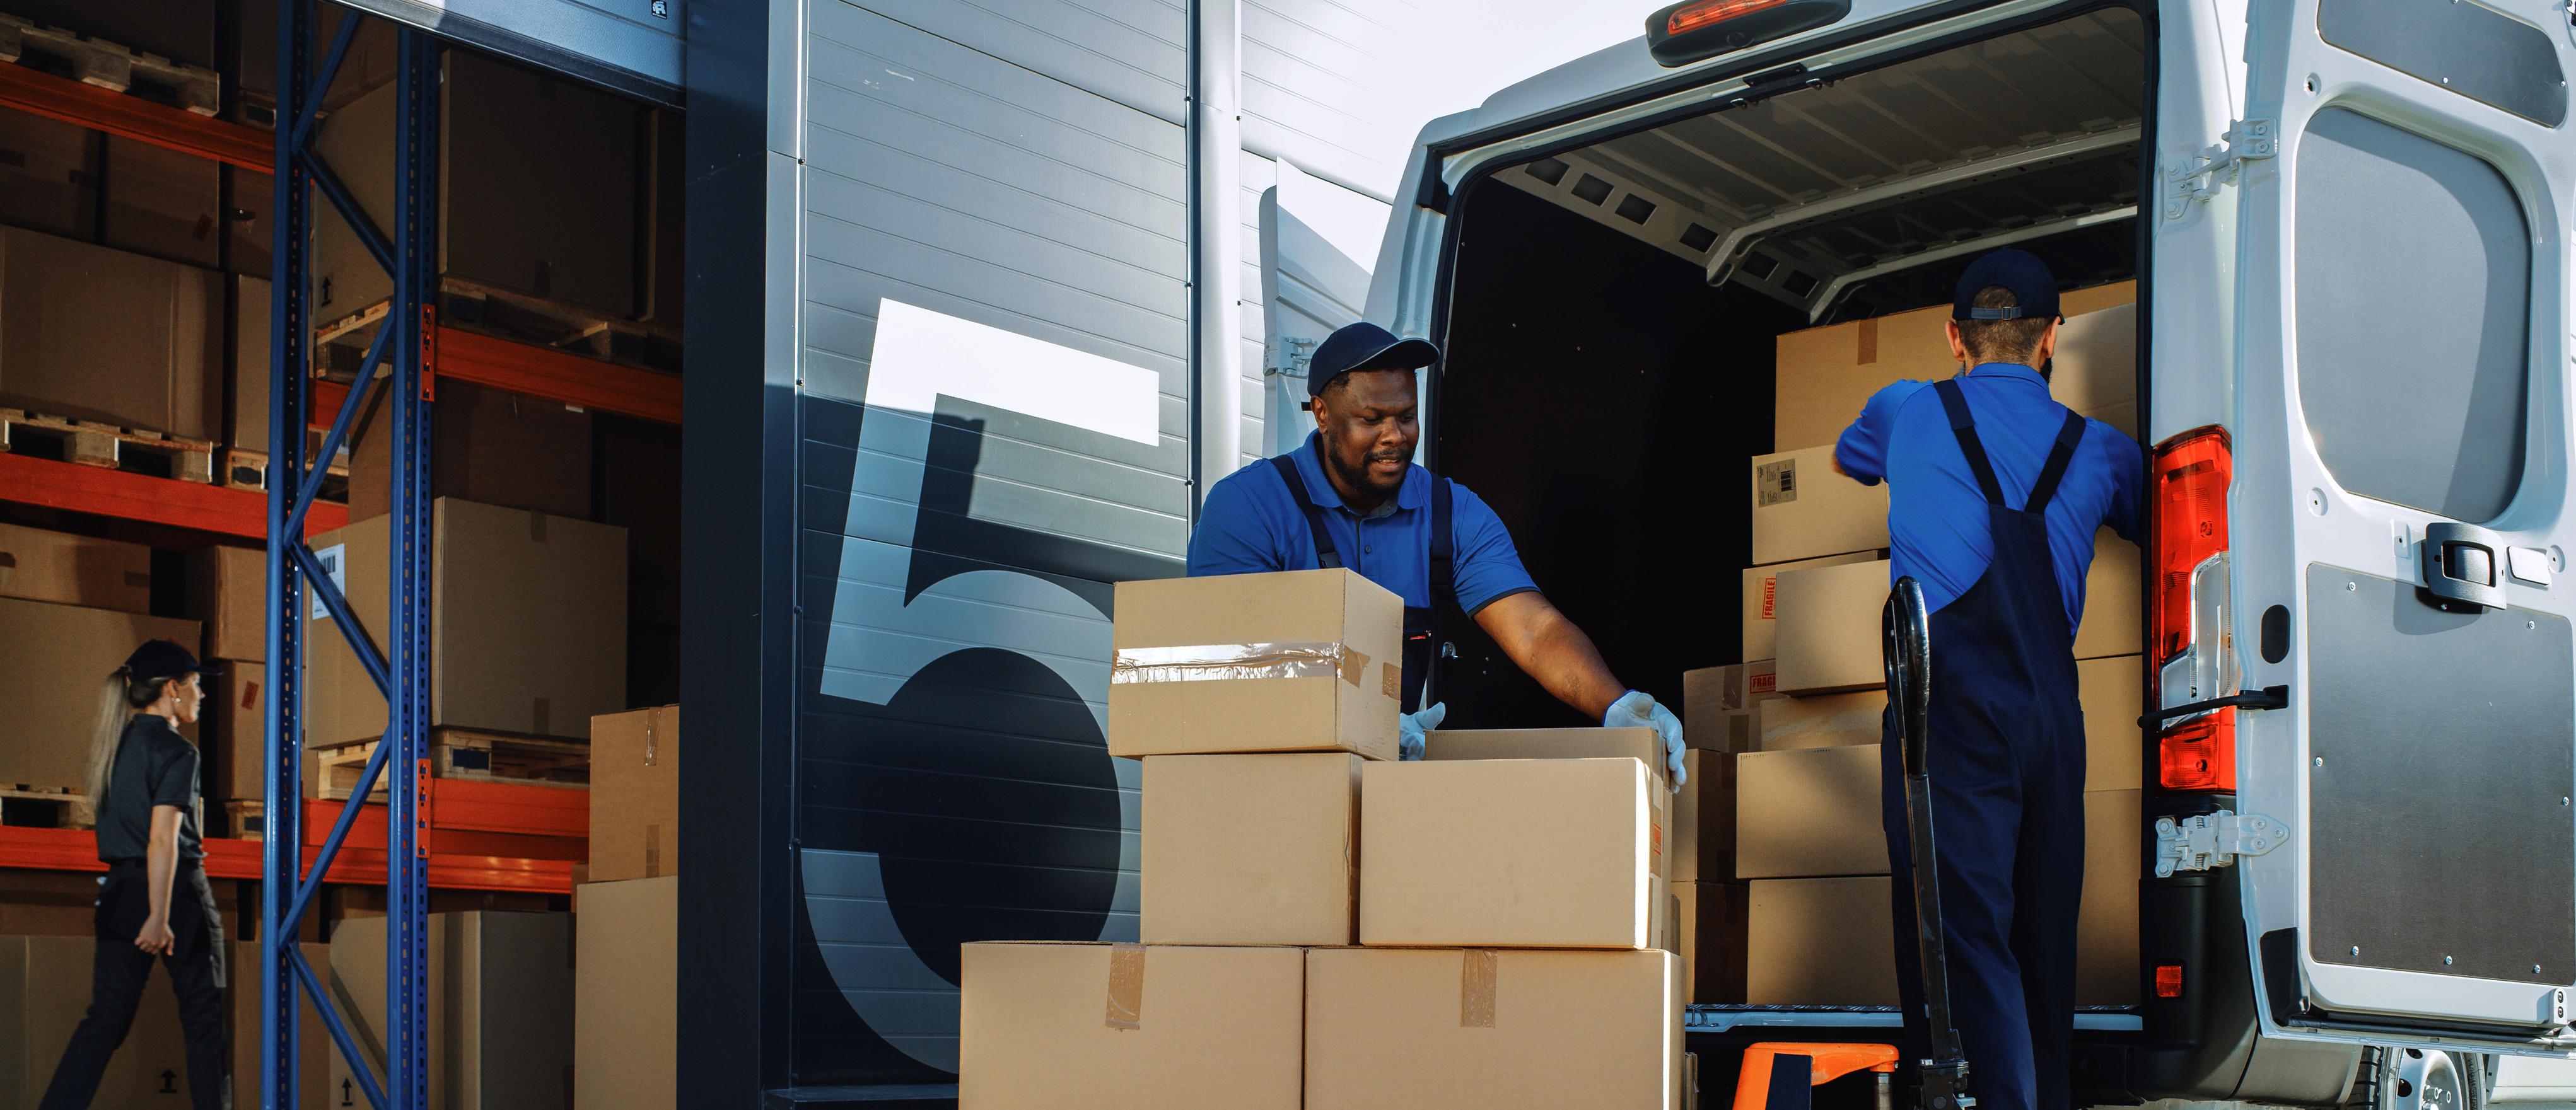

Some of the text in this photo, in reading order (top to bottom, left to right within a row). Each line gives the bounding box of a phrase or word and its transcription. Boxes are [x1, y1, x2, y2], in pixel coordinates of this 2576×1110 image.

[1764, 581, 1775, 616] FRAGILE
[801, 298, 1159, 1074] 5
[1753, 676, 1776, 688] FRAGI
